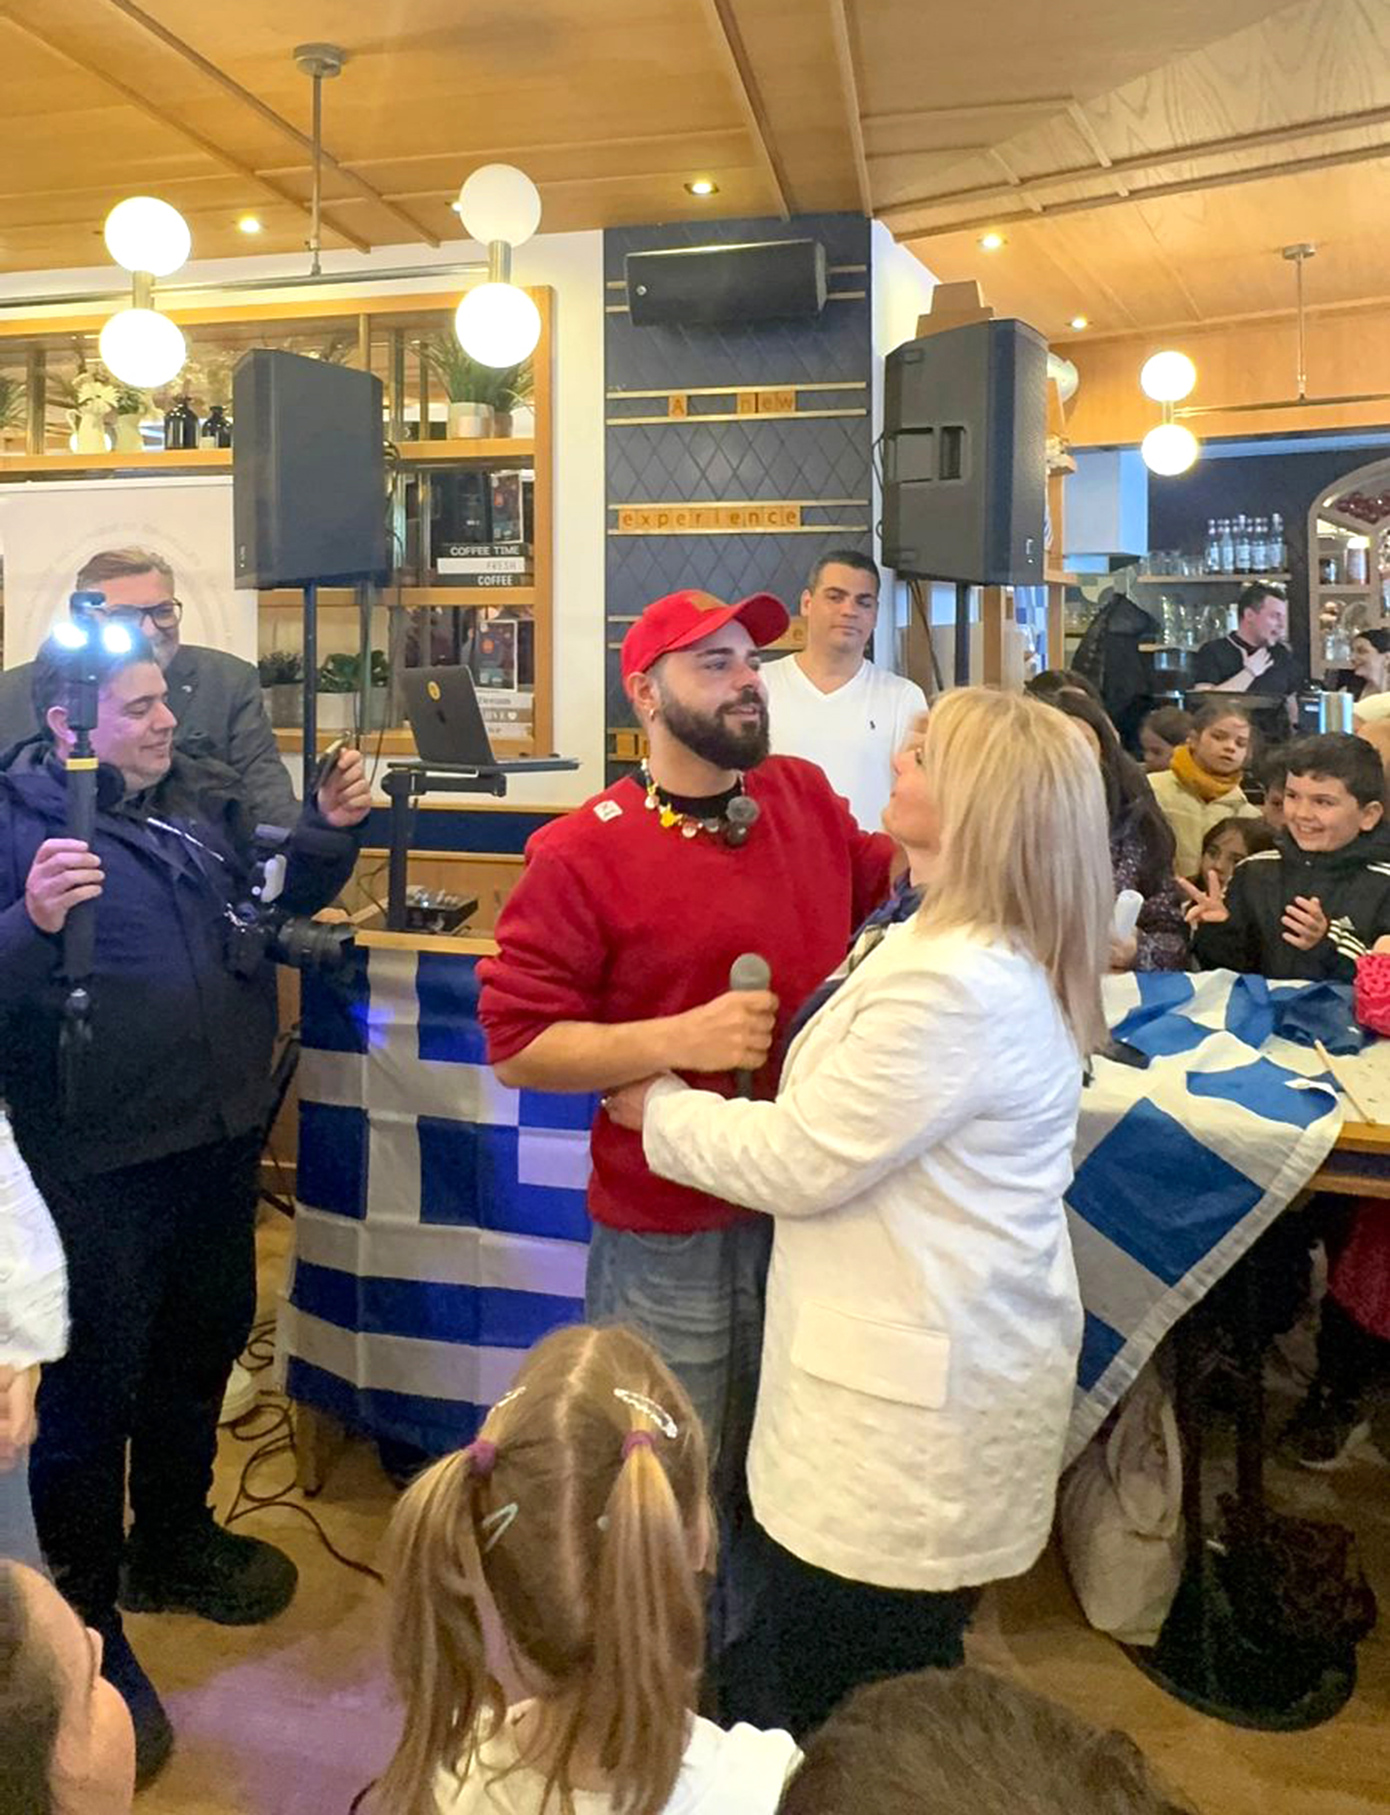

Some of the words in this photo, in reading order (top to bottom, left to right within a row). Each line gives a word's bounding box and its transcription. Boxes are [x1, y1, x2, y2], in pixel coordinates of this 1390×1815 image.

[671, 398, 685, 415] A
[741, 396, 793, 411] new
[622, 509, 797, 529] experience
[450, 546, 490, 556] COFFEE
[493, 545, 520, 555] TIME
[477, 575, 513, 586] COFFEE
